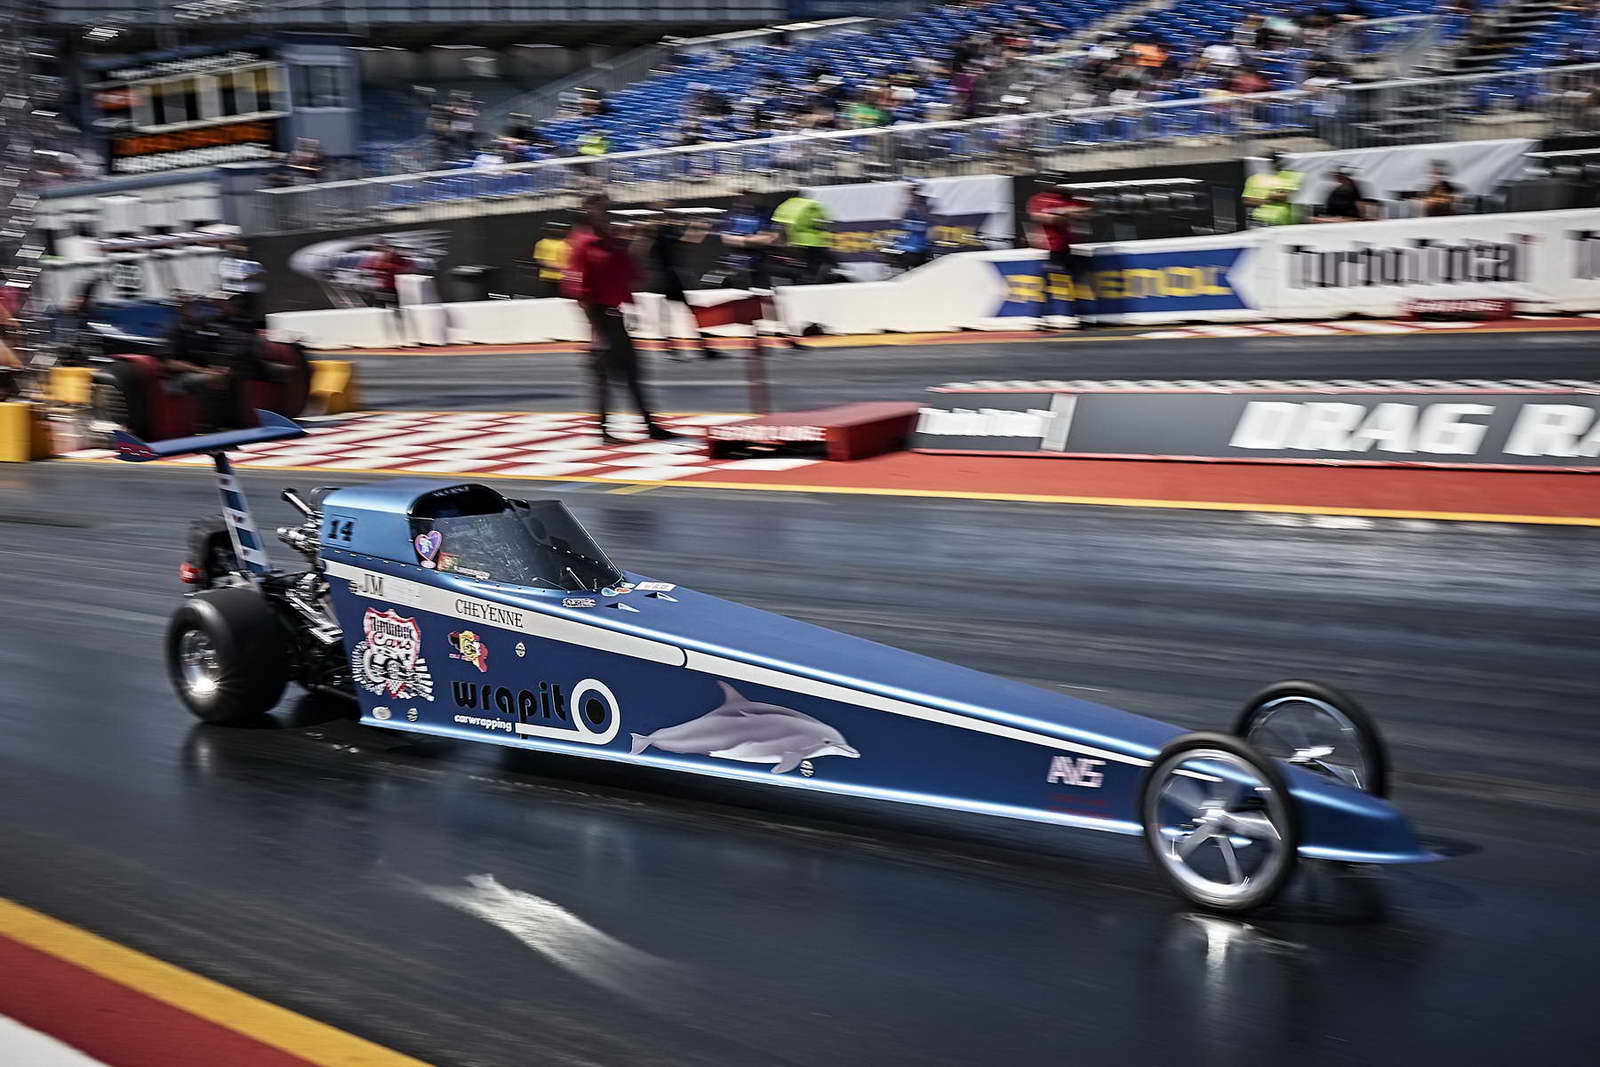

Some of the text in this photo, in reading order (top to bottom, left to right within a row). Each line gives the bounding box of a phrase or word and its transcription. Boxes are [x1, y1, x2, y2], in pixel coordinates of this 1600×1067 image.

[1229, 401, 1496, 455] DRAG
[328, 519, 353, 542] 14
[455, 598, 524, 629] CHEYENNE
[453, 713, 513, 733] carwrapping
